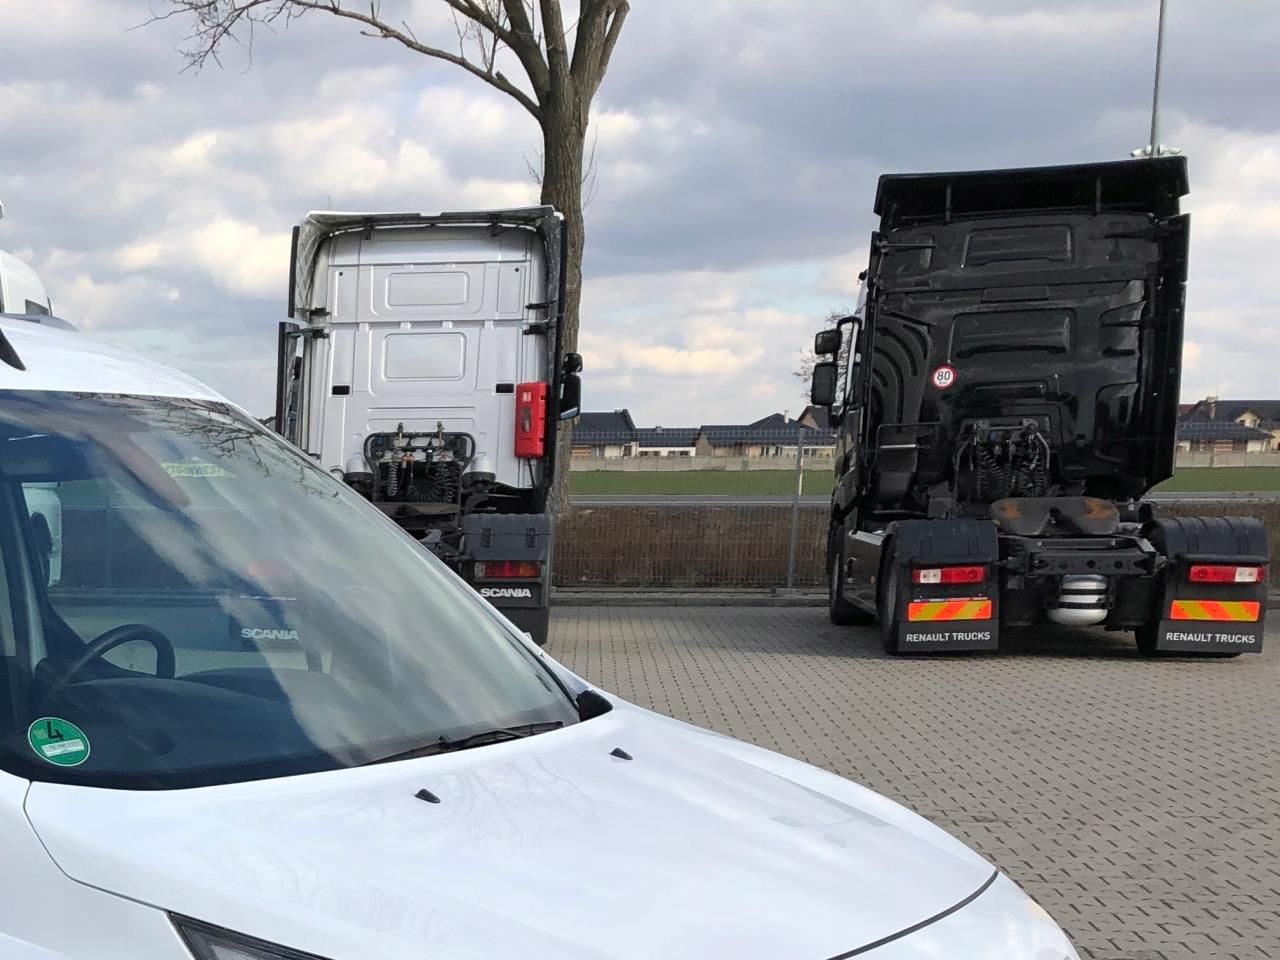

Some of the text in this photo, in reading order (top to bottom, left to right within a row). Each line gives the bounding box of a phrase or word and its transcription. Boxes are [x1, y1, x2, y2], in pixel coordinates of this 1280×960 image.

[937, 371, 951, 381] 80
[480, 588, 531, 598] SCANIA
[241, 628, 299, 640] SCANIA
[906, 632, 991, 642] RENAULT TRUCKS
[1166, 632, 1256, 644] RENAULT TRUCKS
